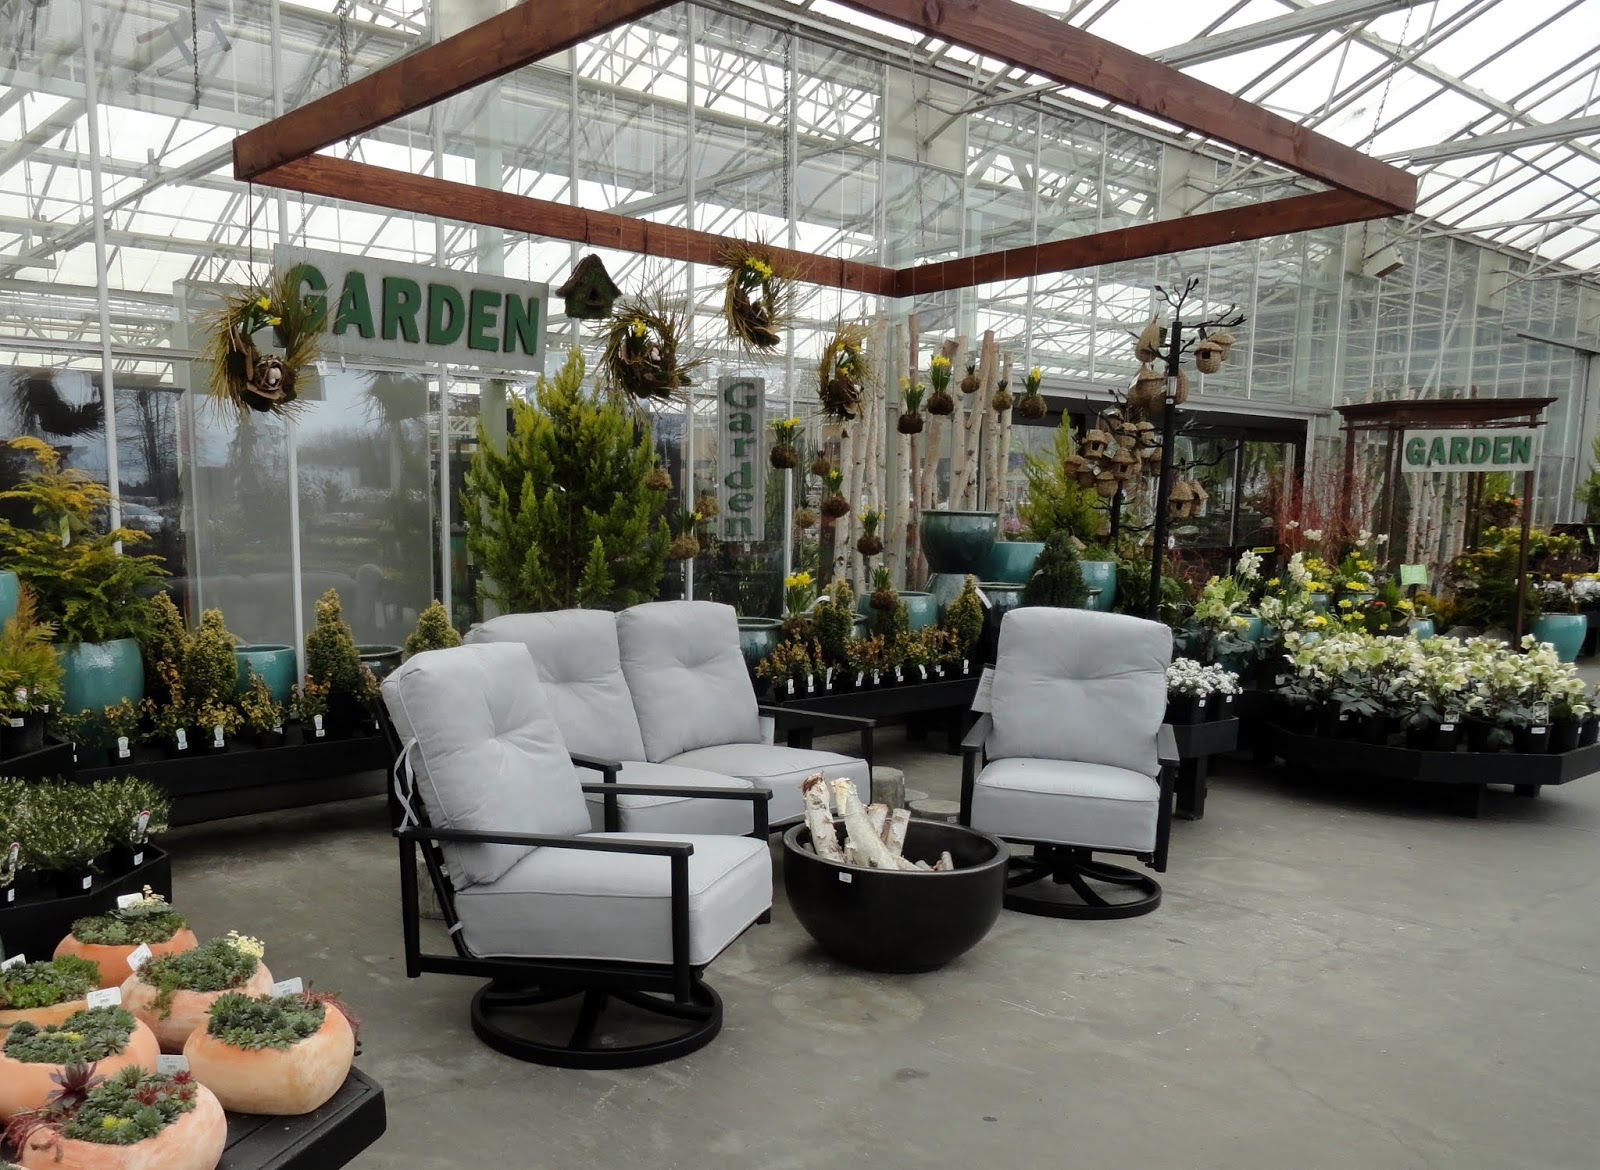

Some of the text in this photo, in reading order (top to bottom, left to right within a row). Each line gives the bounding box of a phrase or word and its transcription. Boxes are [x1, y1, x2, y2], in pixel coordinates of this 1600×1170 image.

[283, 264, 540, 356] GARDEN
[724, 381, 758, 537] Garden
[1405, 436, 1532, 468] GARDEN
